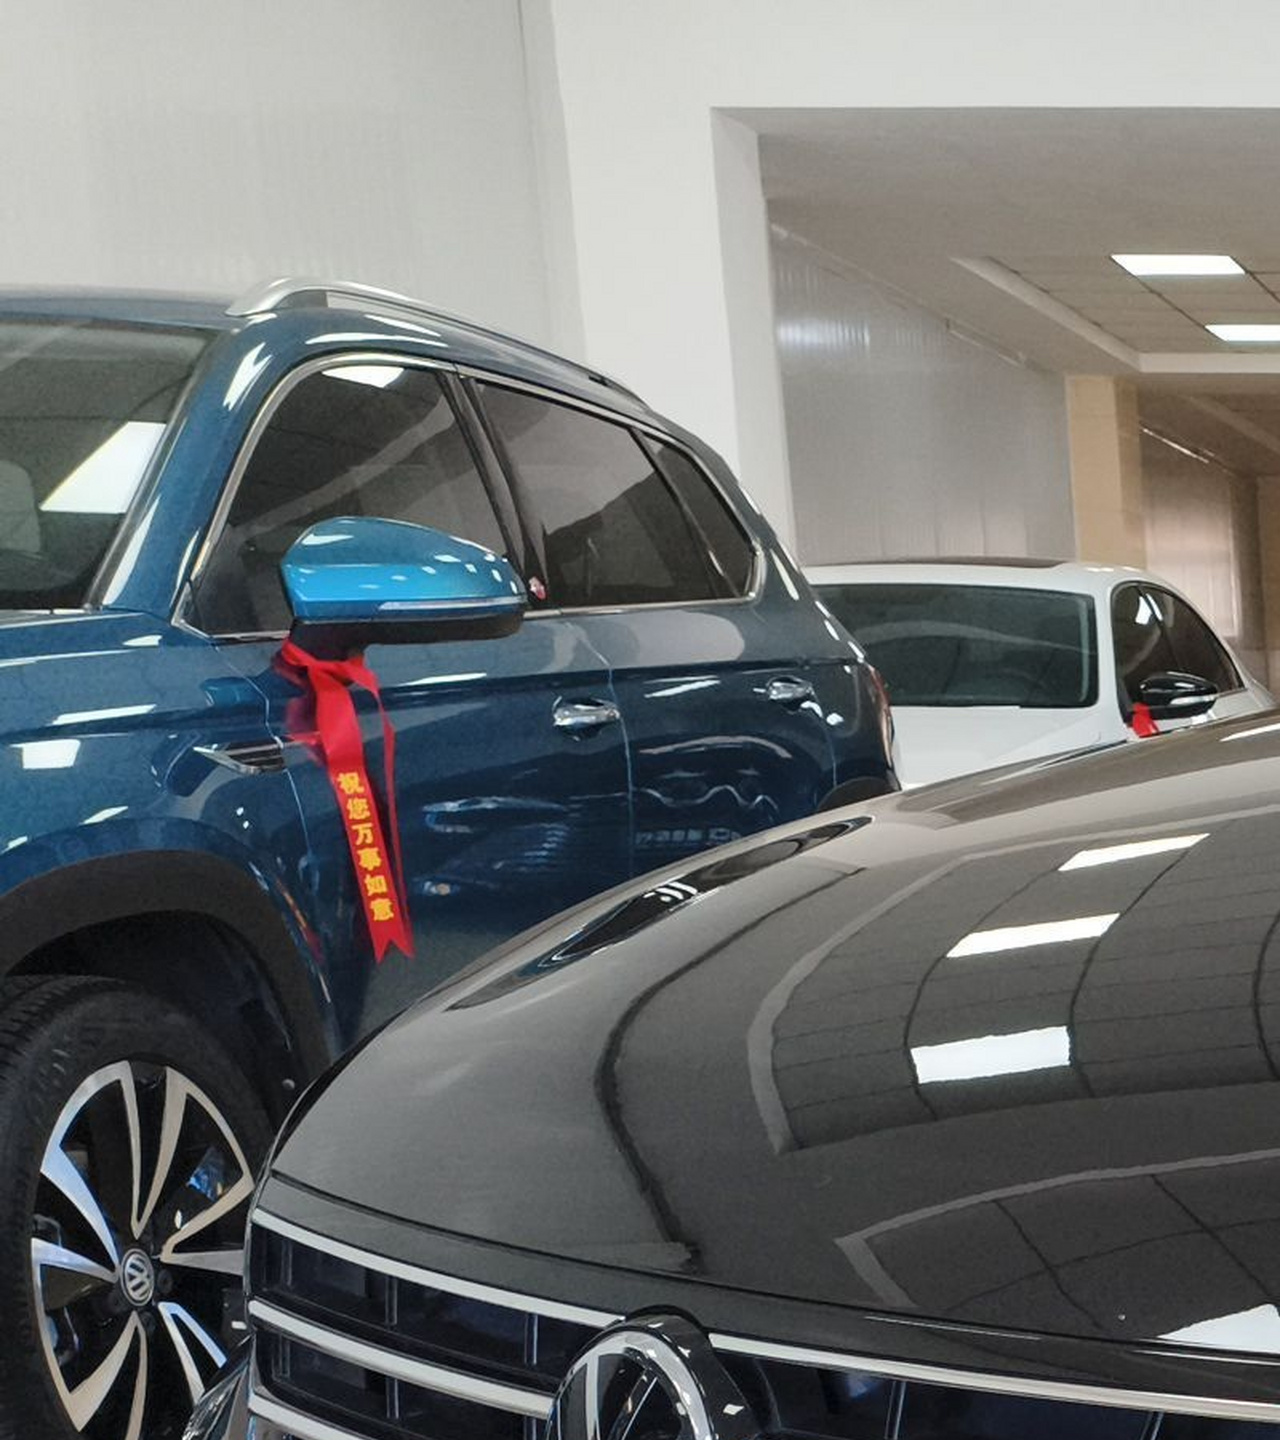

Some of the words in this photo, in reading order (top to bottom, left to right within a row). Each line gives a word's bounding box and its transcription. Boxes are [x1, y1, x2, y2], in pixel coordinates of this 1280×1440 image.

[337, 771, 394, 922] 祝您万事如意
